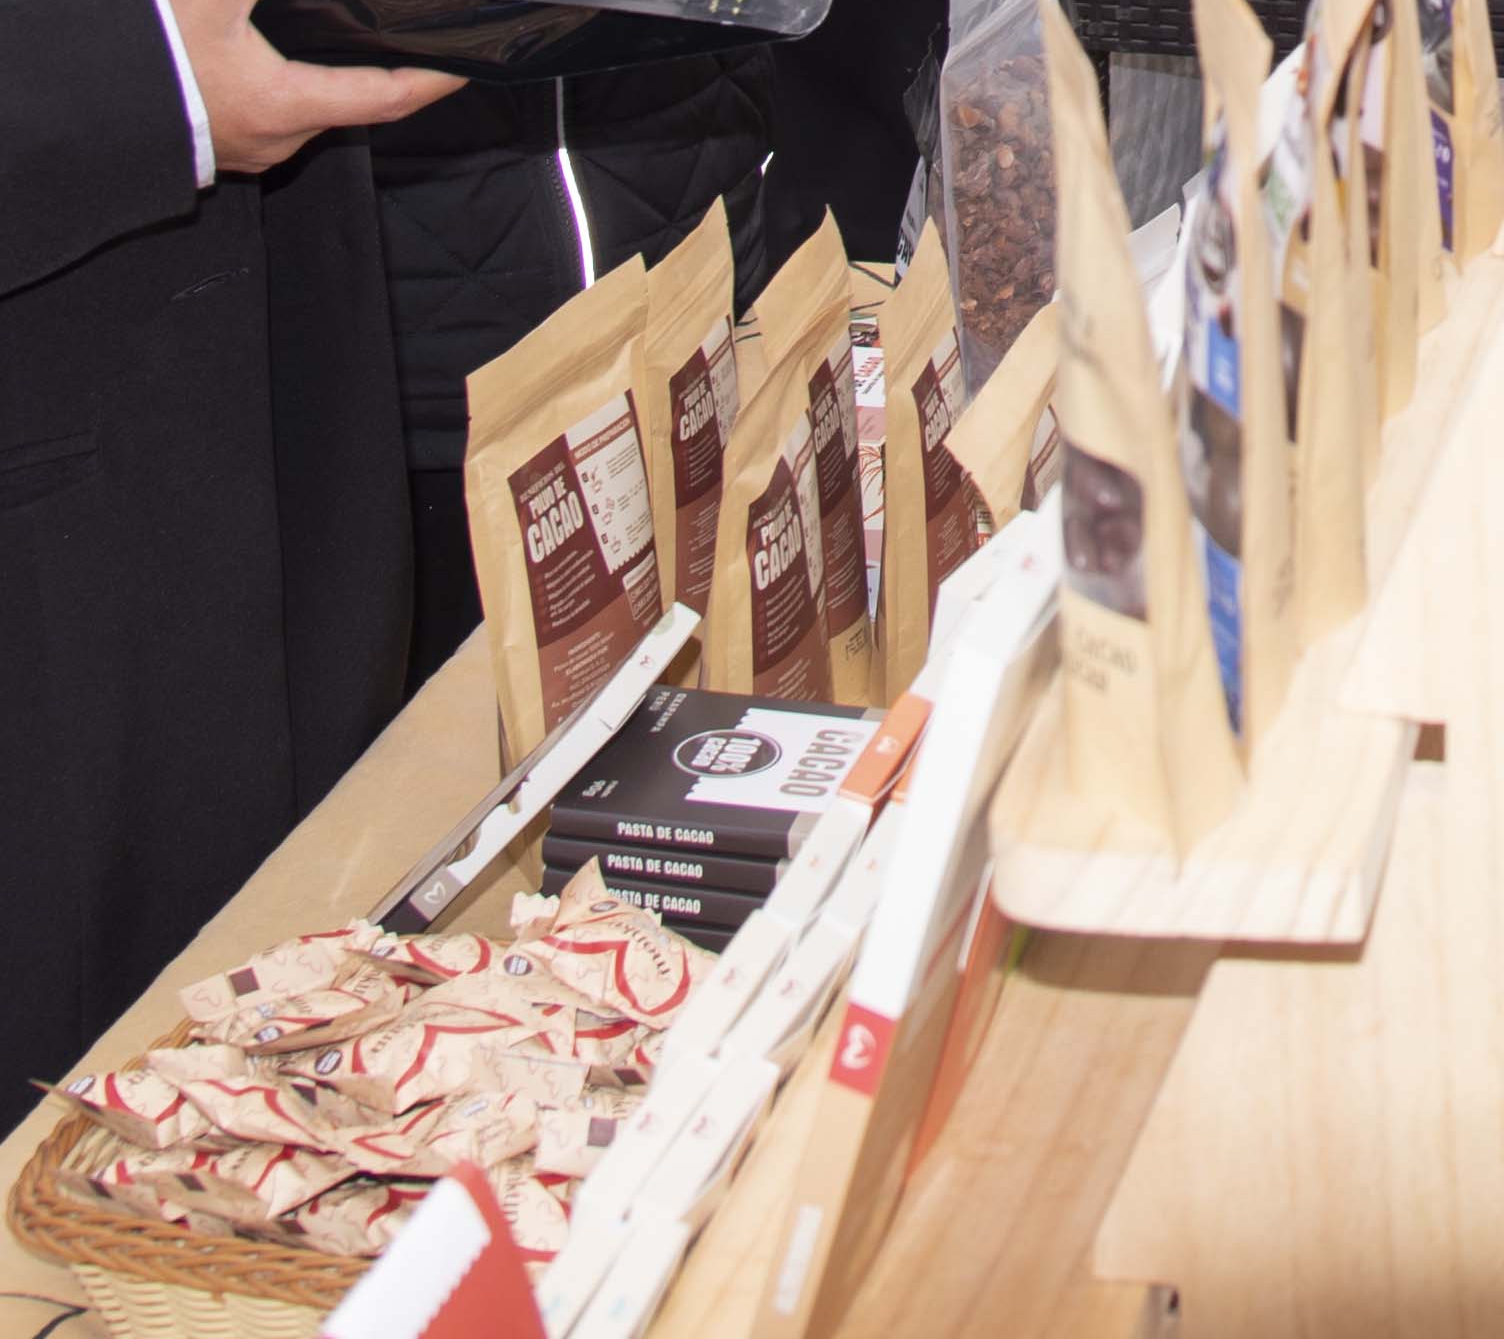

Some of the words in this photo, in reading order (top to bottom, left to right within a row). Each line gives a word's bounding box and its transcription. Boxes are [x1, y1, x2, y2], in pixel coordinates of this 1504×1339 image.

[679, 390, 714, 441] CACAO
[527, 490, 584, 564] CACAO
[754, 513, 803, 590] CACAO
[711, 736, 763, 773] 100%
[779, 728, 850, 797] CACAO
[617, 822, 654, 839] PASTA
[656, 826, 672, 841] DE
[675, 827, 715, 845] CACAO
[607, 854, 643, 871] PASTA
[646, 858, 662, 873] DE
[664, 861, 704, 879] CACAO
[645, 891, 660, 909] DE
[663, 896, 702, 914] CACAO
